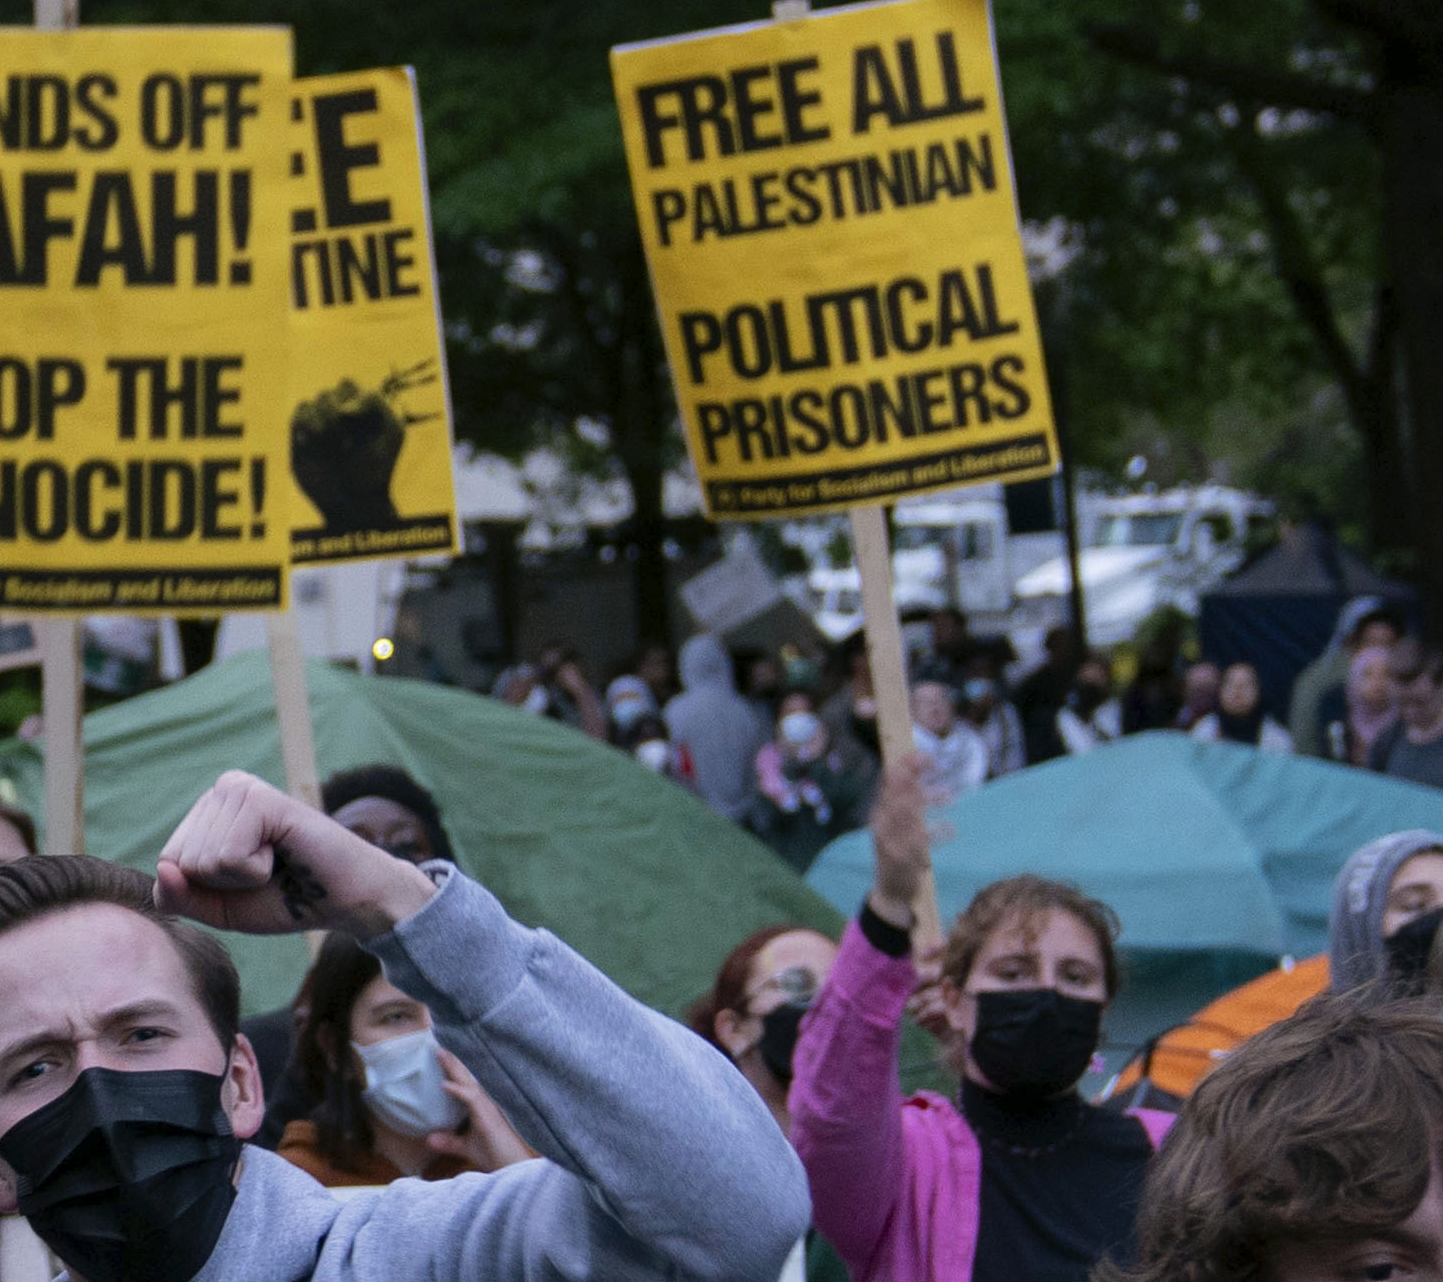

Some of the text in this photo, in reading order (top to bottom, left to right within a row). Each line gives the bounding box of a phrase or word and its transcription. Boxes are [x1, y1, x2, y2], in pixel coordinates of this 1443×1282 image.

[141, 73, 261, 152] OFF
[635, 32, 985, 170] FREE ALL
[652, 133, 996, 247] PALESTINIAN
[293, 228, 420, 309] TINE
[679, 263, 1019, 386] POLITICAL
[107, 355, 244, 441] THE
[696, 354, 1032, 466] PRISONERS
[817, 468, 909, 501] Socialism
[912, 458, 950, 484] and
[951, 442, 1045, 480] Liberation
[4, 574, 112, 602] Socialism
[115, 575, 161, 602] and
[163, 574, 276, 602] Liberation
